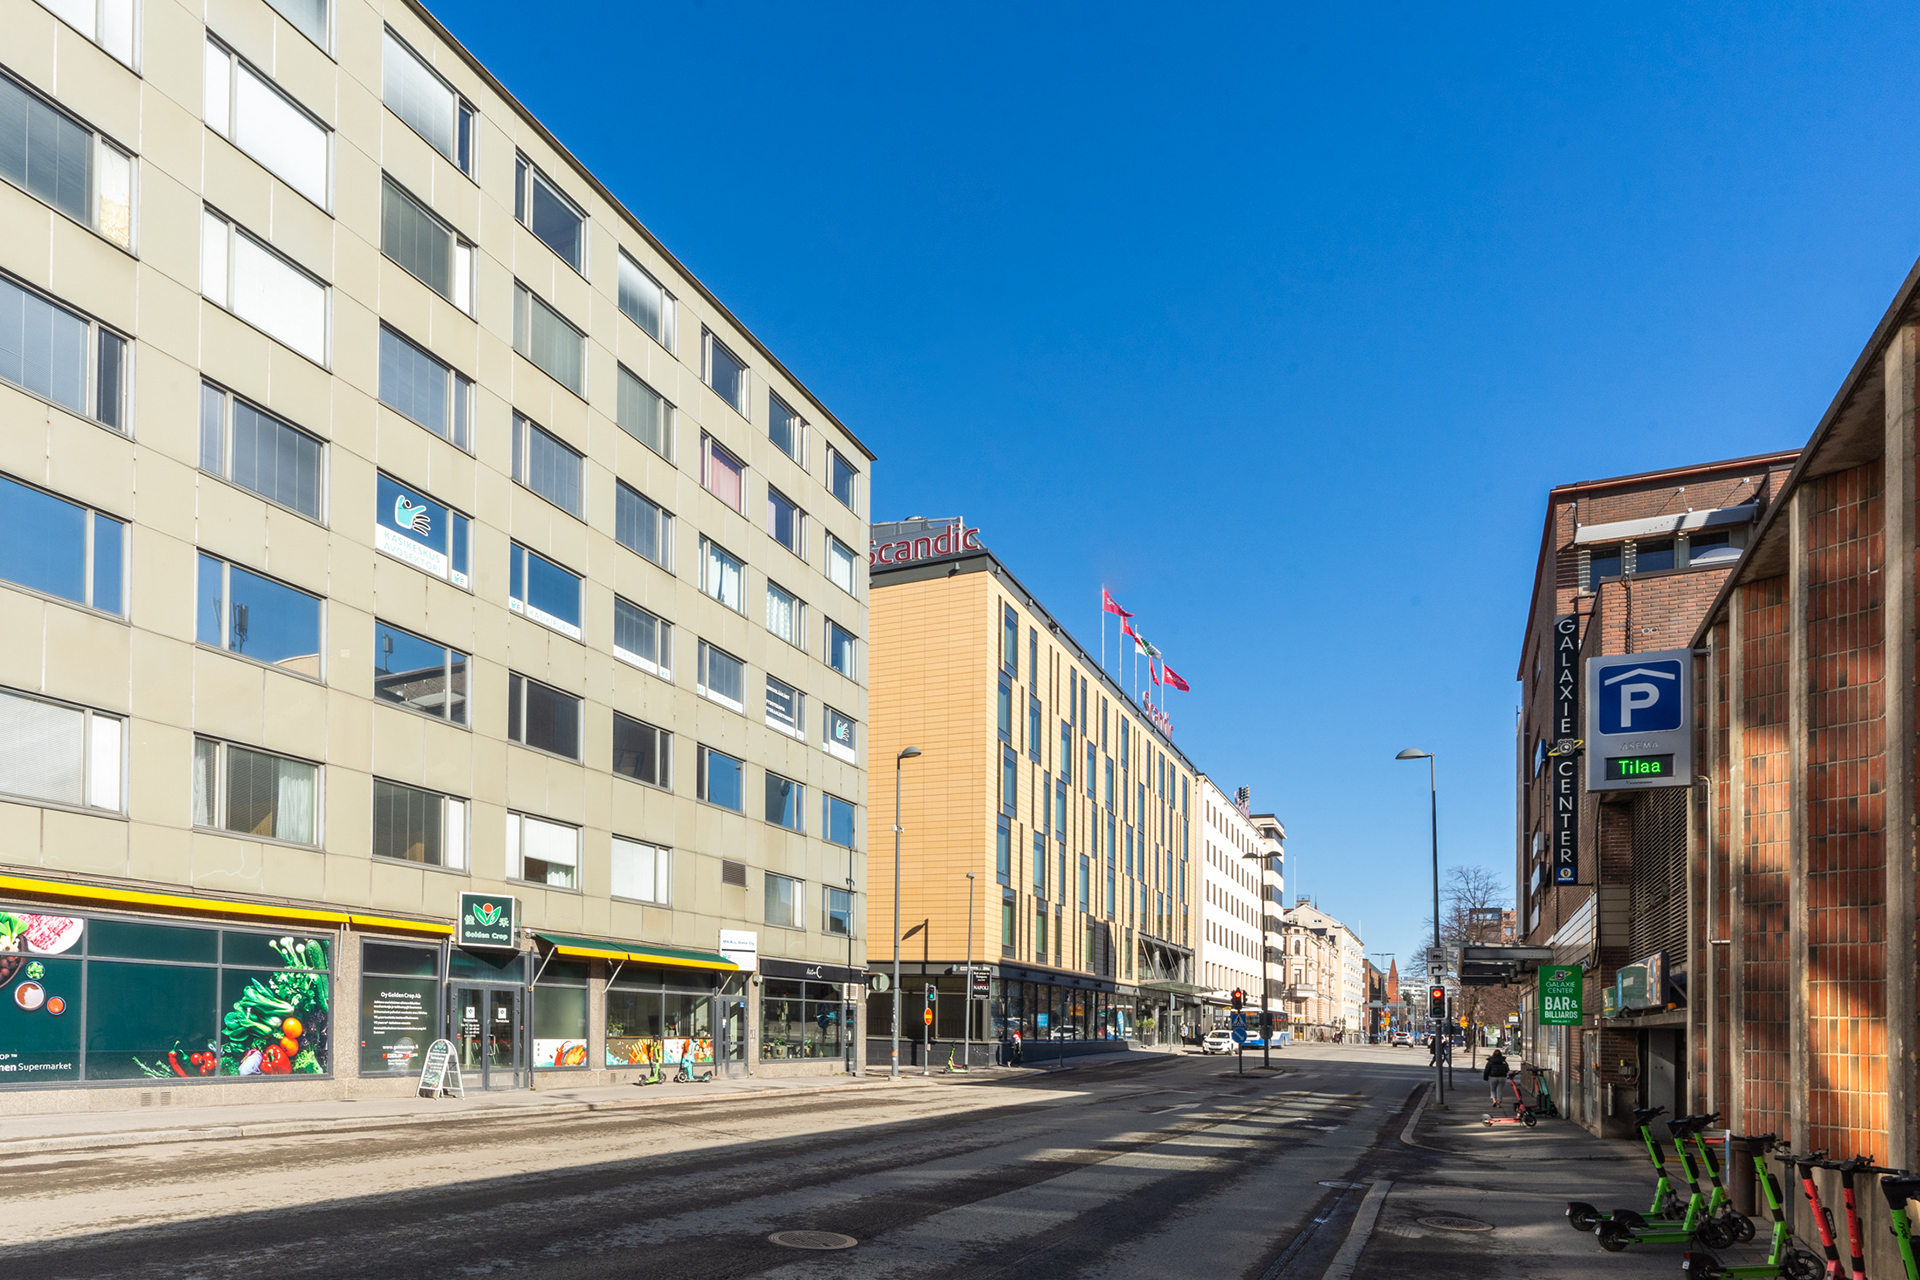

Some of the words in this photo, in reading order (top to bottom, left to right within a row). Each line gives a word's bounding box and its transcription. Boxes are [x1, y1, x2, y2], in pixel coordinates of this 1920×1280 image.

[384, 542, 441, 574] AVOSEKTORI
[1558, 619, 1576, 733] GALAXIE
[1620, 683, 1660, 728] P
[1621, 741, 1659, 750] ASEMA
[1618, 759, 1661, 775] Tilaa
[1558, 761, 1573, 863] CENTER
[465, 930, 490, 939] Golden
[491, 932, 508, 941] Crop
[1545, 996, 1570, 1010] BAR
[1571, 1000, 1578, 1009] &
[1544, 1010, 1578, 1019] BILLIARDS
[18, 1062, 72, 1072] Supermarket
